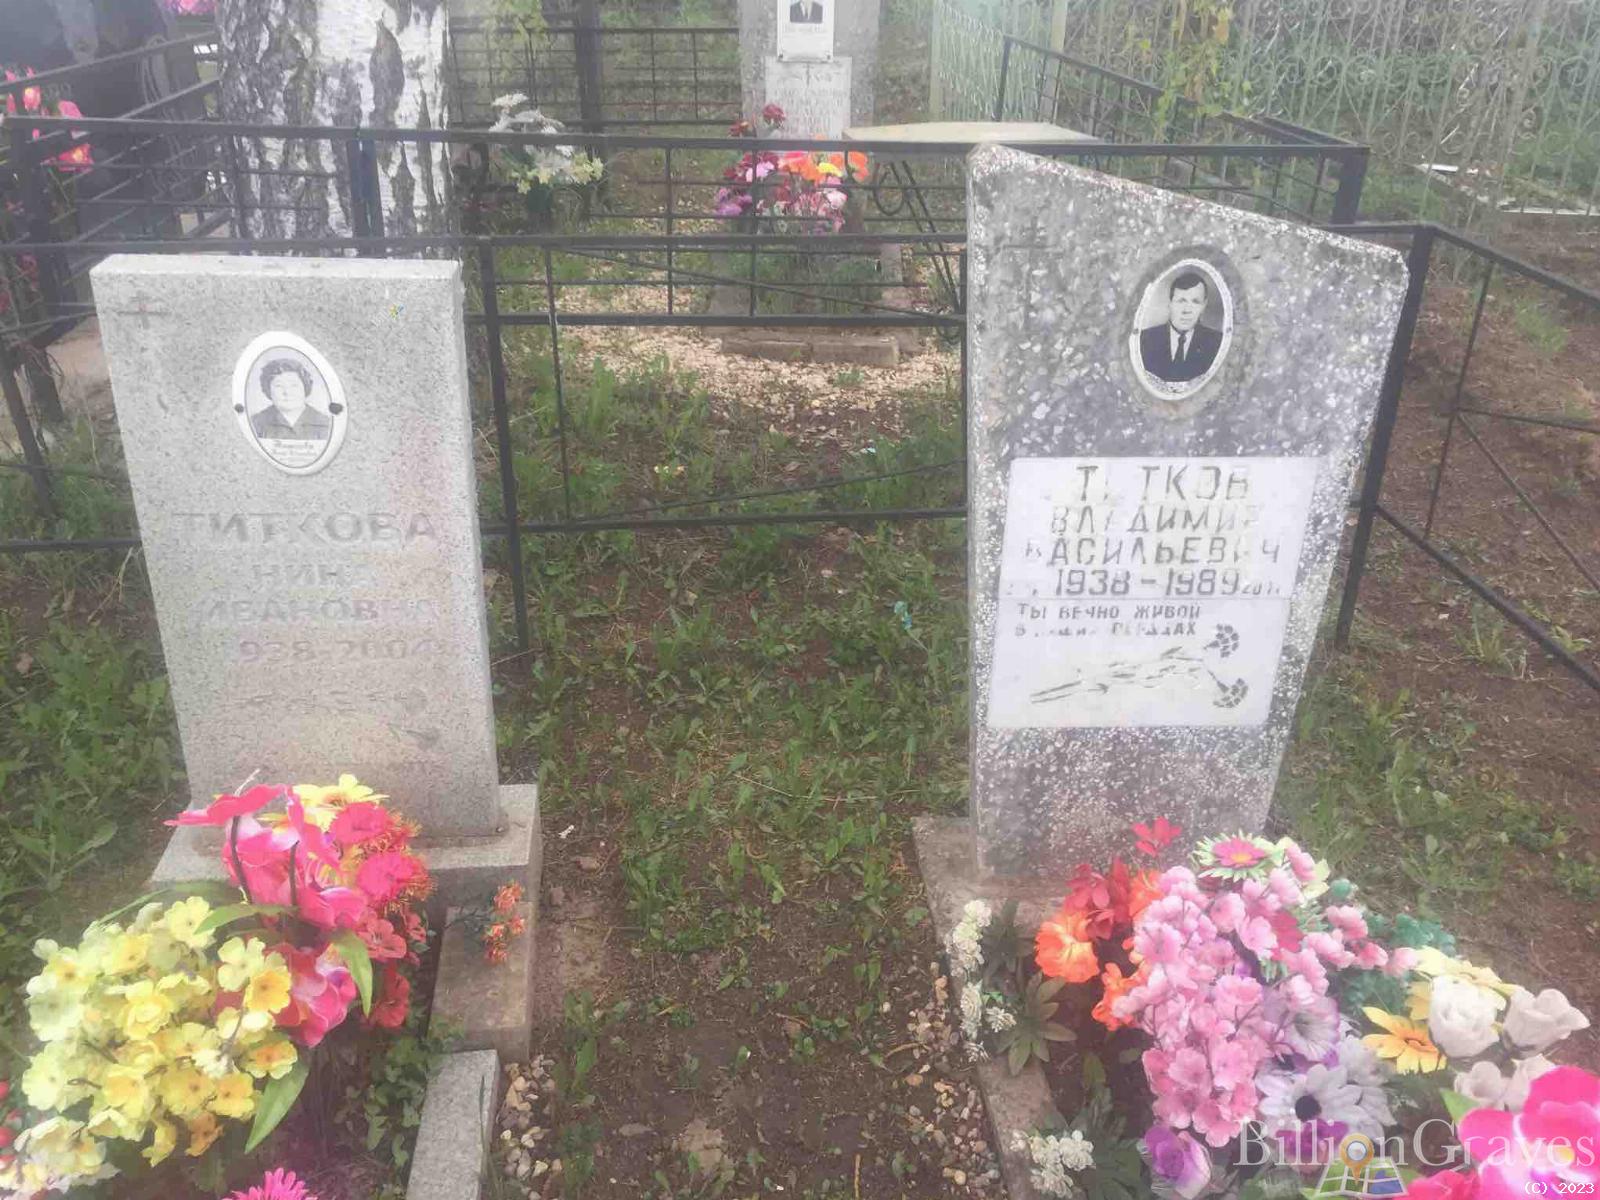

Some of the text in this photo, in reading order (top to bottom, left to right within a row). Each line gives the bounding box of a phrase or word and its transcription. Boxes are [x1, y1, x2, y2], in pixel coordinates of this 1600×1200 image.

[1076, 465, 1249, 501] ТТКОВ
[252, 562, 374, 588] НИН
[1018, 602, 1046, 619] ТЫ
[1059, 604, 1120, 619] ВЕЧНО
